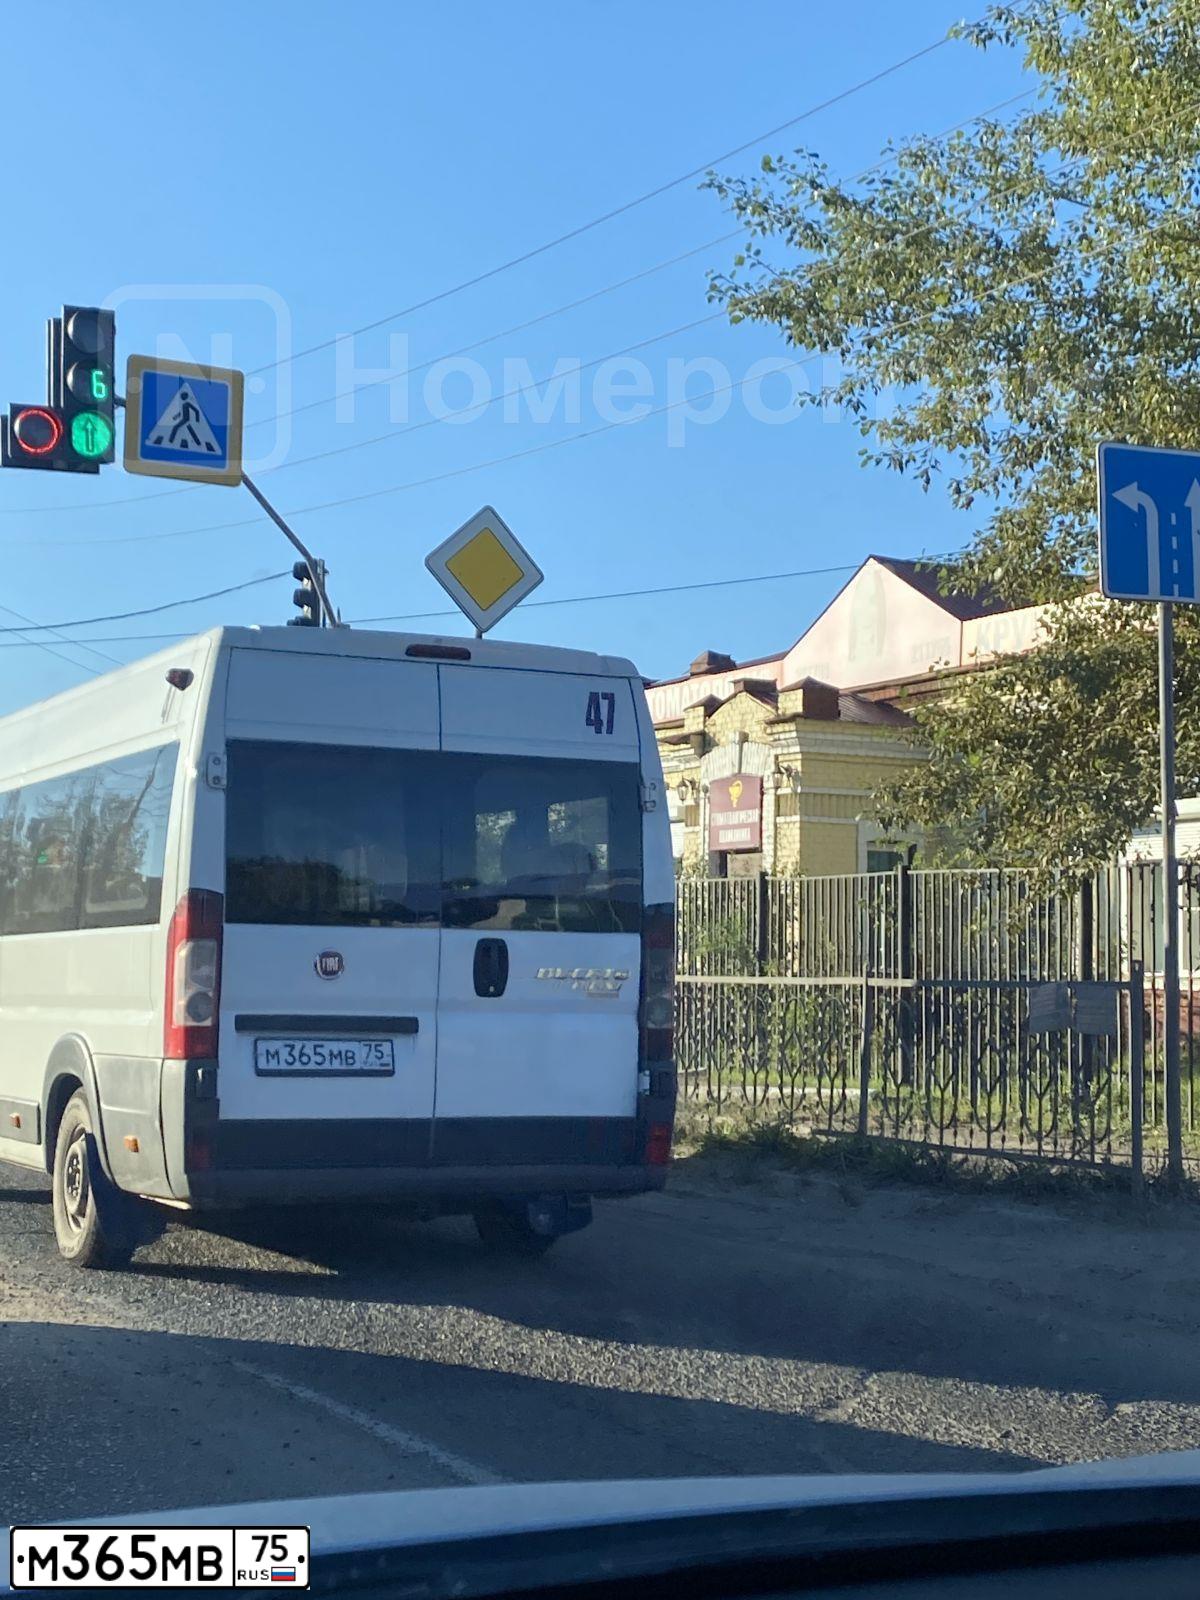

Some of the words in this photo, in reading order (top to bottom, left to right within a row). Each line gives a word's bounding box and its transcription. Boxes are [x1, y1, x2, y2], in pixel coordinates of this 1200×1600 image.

[91, 369, 107, 400] 6
[585, 691, 615, 735] 47
[362, 1043, 385, 1061] 75
